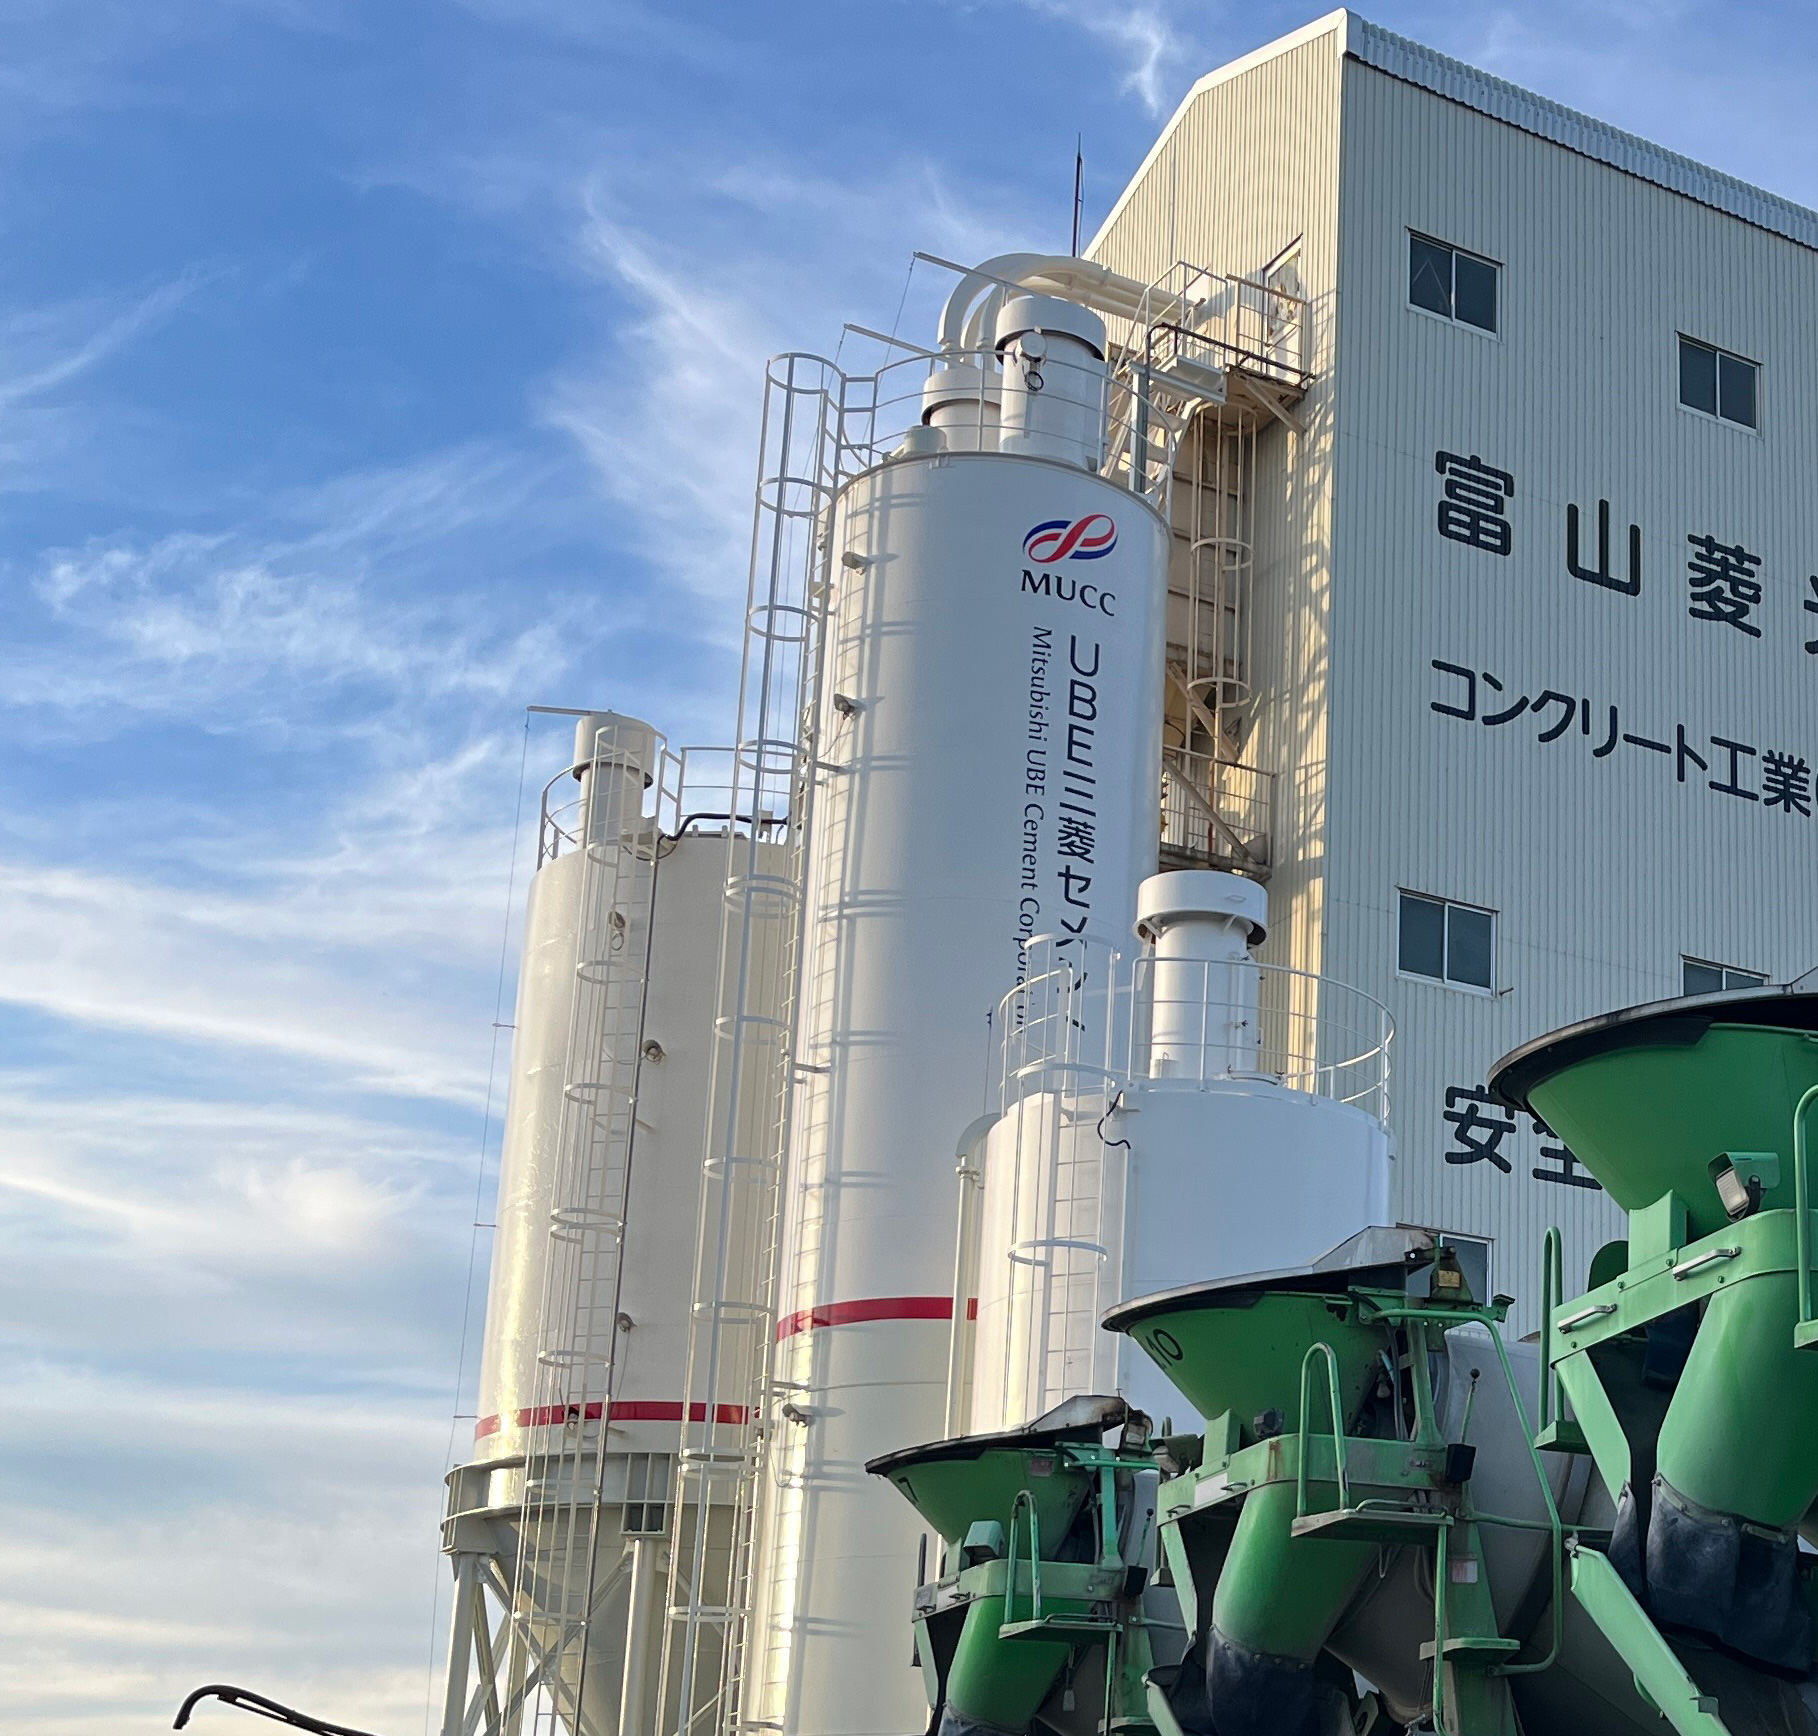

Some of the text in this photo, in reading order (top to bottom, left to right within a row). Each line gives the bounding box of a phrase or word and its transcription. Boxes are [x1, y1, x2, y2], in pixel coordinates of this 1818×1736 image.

[1020, 568, 1116, 617] MUCC
[1028, 626, 1054, 741] Mitsubishi
[1024, 748, 1048, 796] UBE
[1019, 803, 1046, 890] Cement
